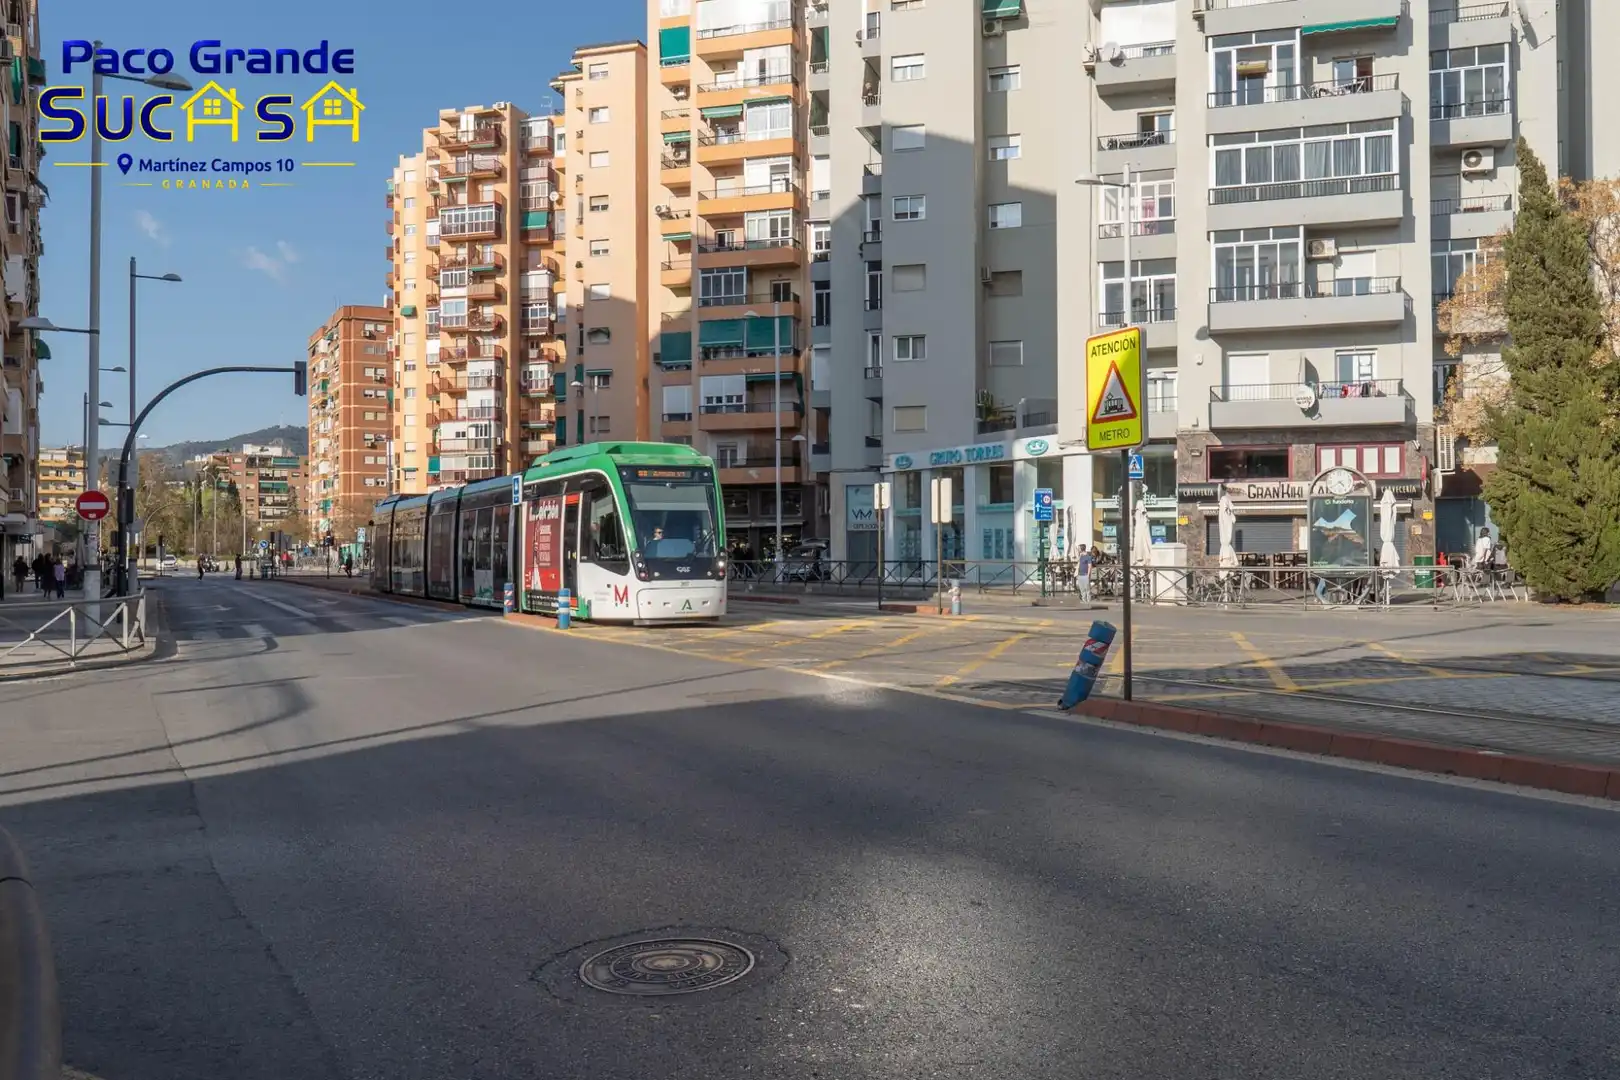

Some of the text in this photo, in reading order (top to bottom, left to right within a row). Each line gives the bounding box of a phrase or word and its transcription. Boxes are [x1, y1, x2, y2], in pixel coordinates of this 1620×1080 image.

[1090, 335, 1136, 358] ATENCIÓN
[1099, 428, 1130, 441] METRO
[930, 444, 1004, 466] GRUPO TORRES
[1247, 484, 1279, 499] GRAN
[1281, 483, 1303, 499] KIKI
